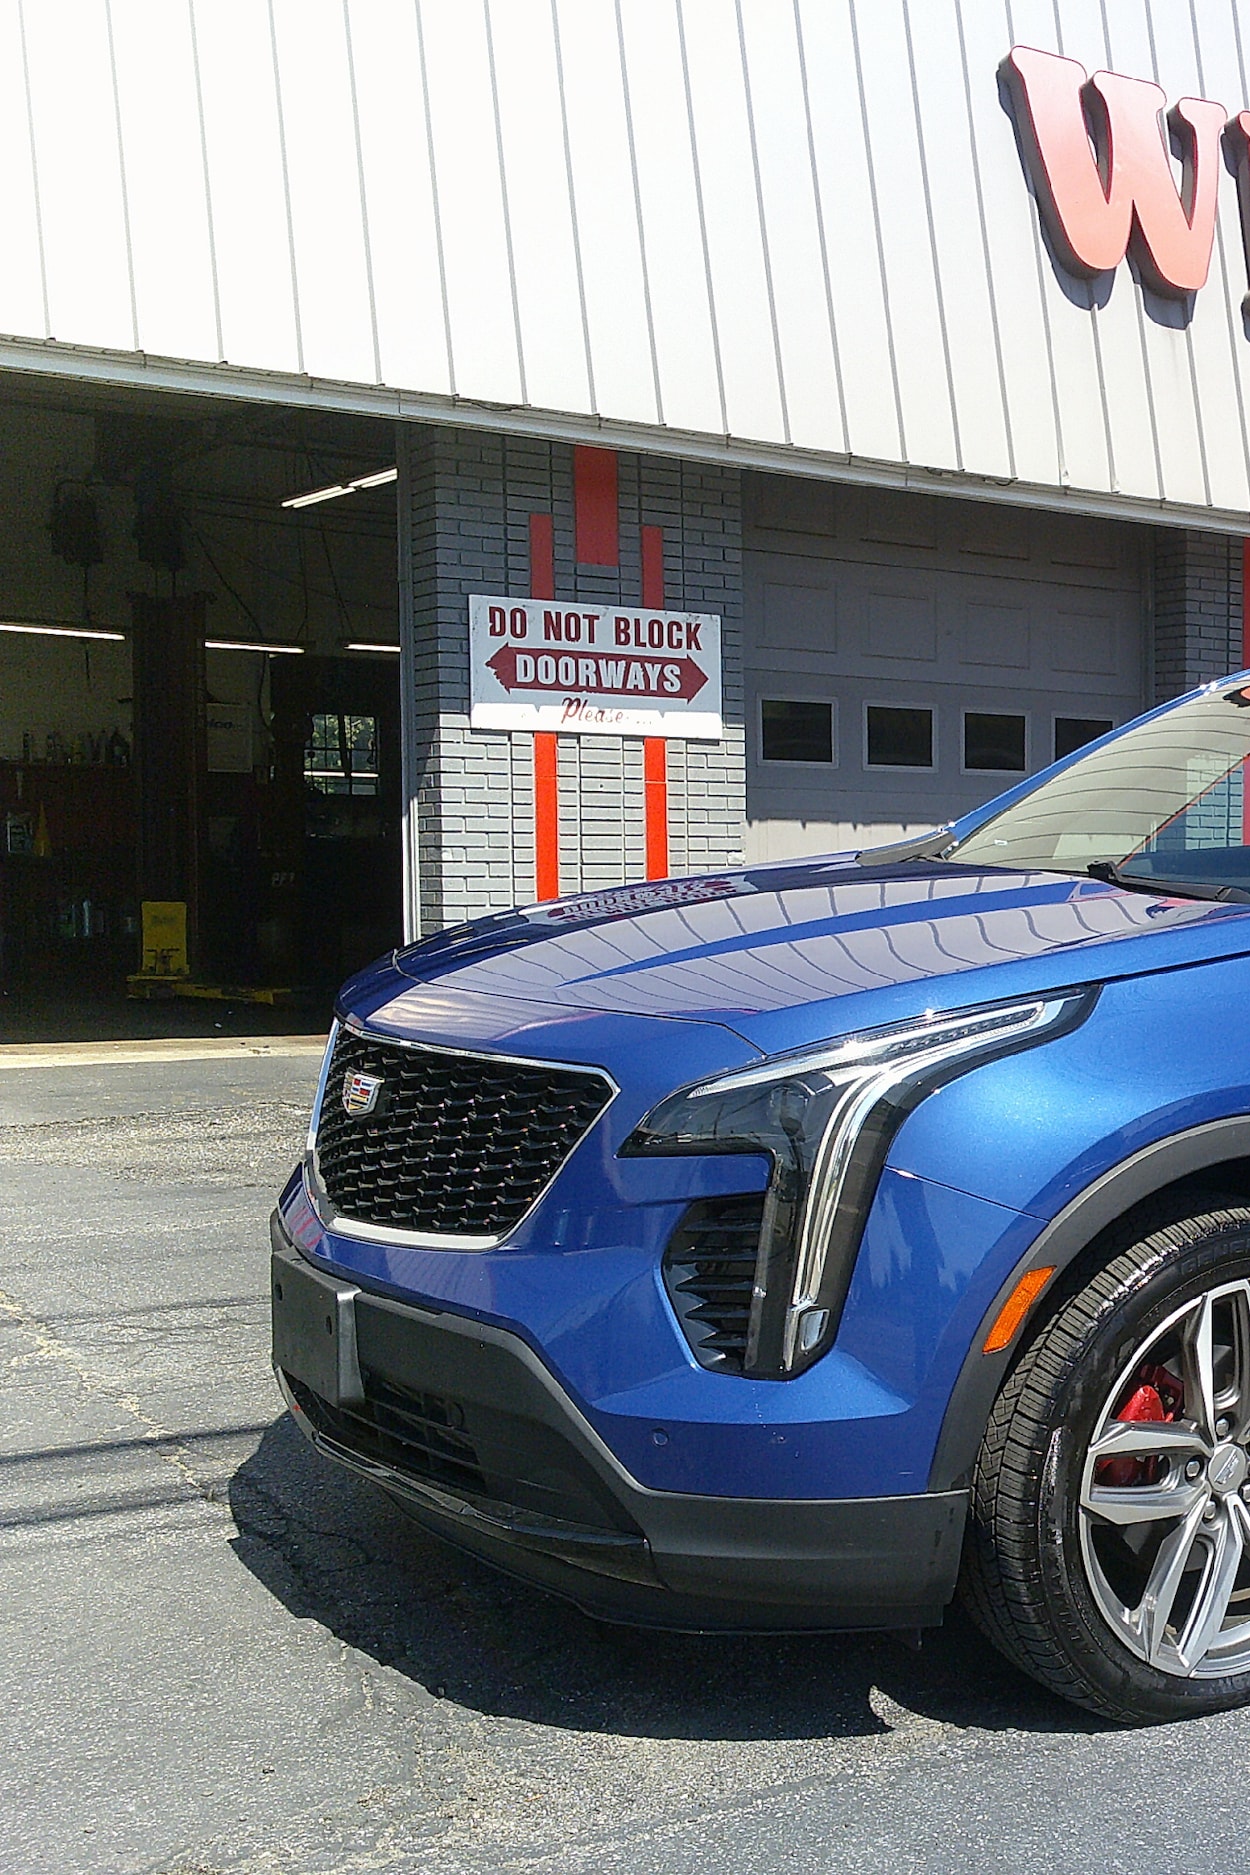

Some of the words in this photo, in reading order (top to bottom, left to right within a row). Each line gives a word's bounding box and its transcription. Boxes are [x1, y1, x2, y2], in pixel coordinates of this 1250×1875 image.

[488, 606, 527, 639] DO
[543, 610, 600, 644] NOT
[614, 616, 703, 651] BLOCK
[515, 654, 682, 693] DOORWAYS
